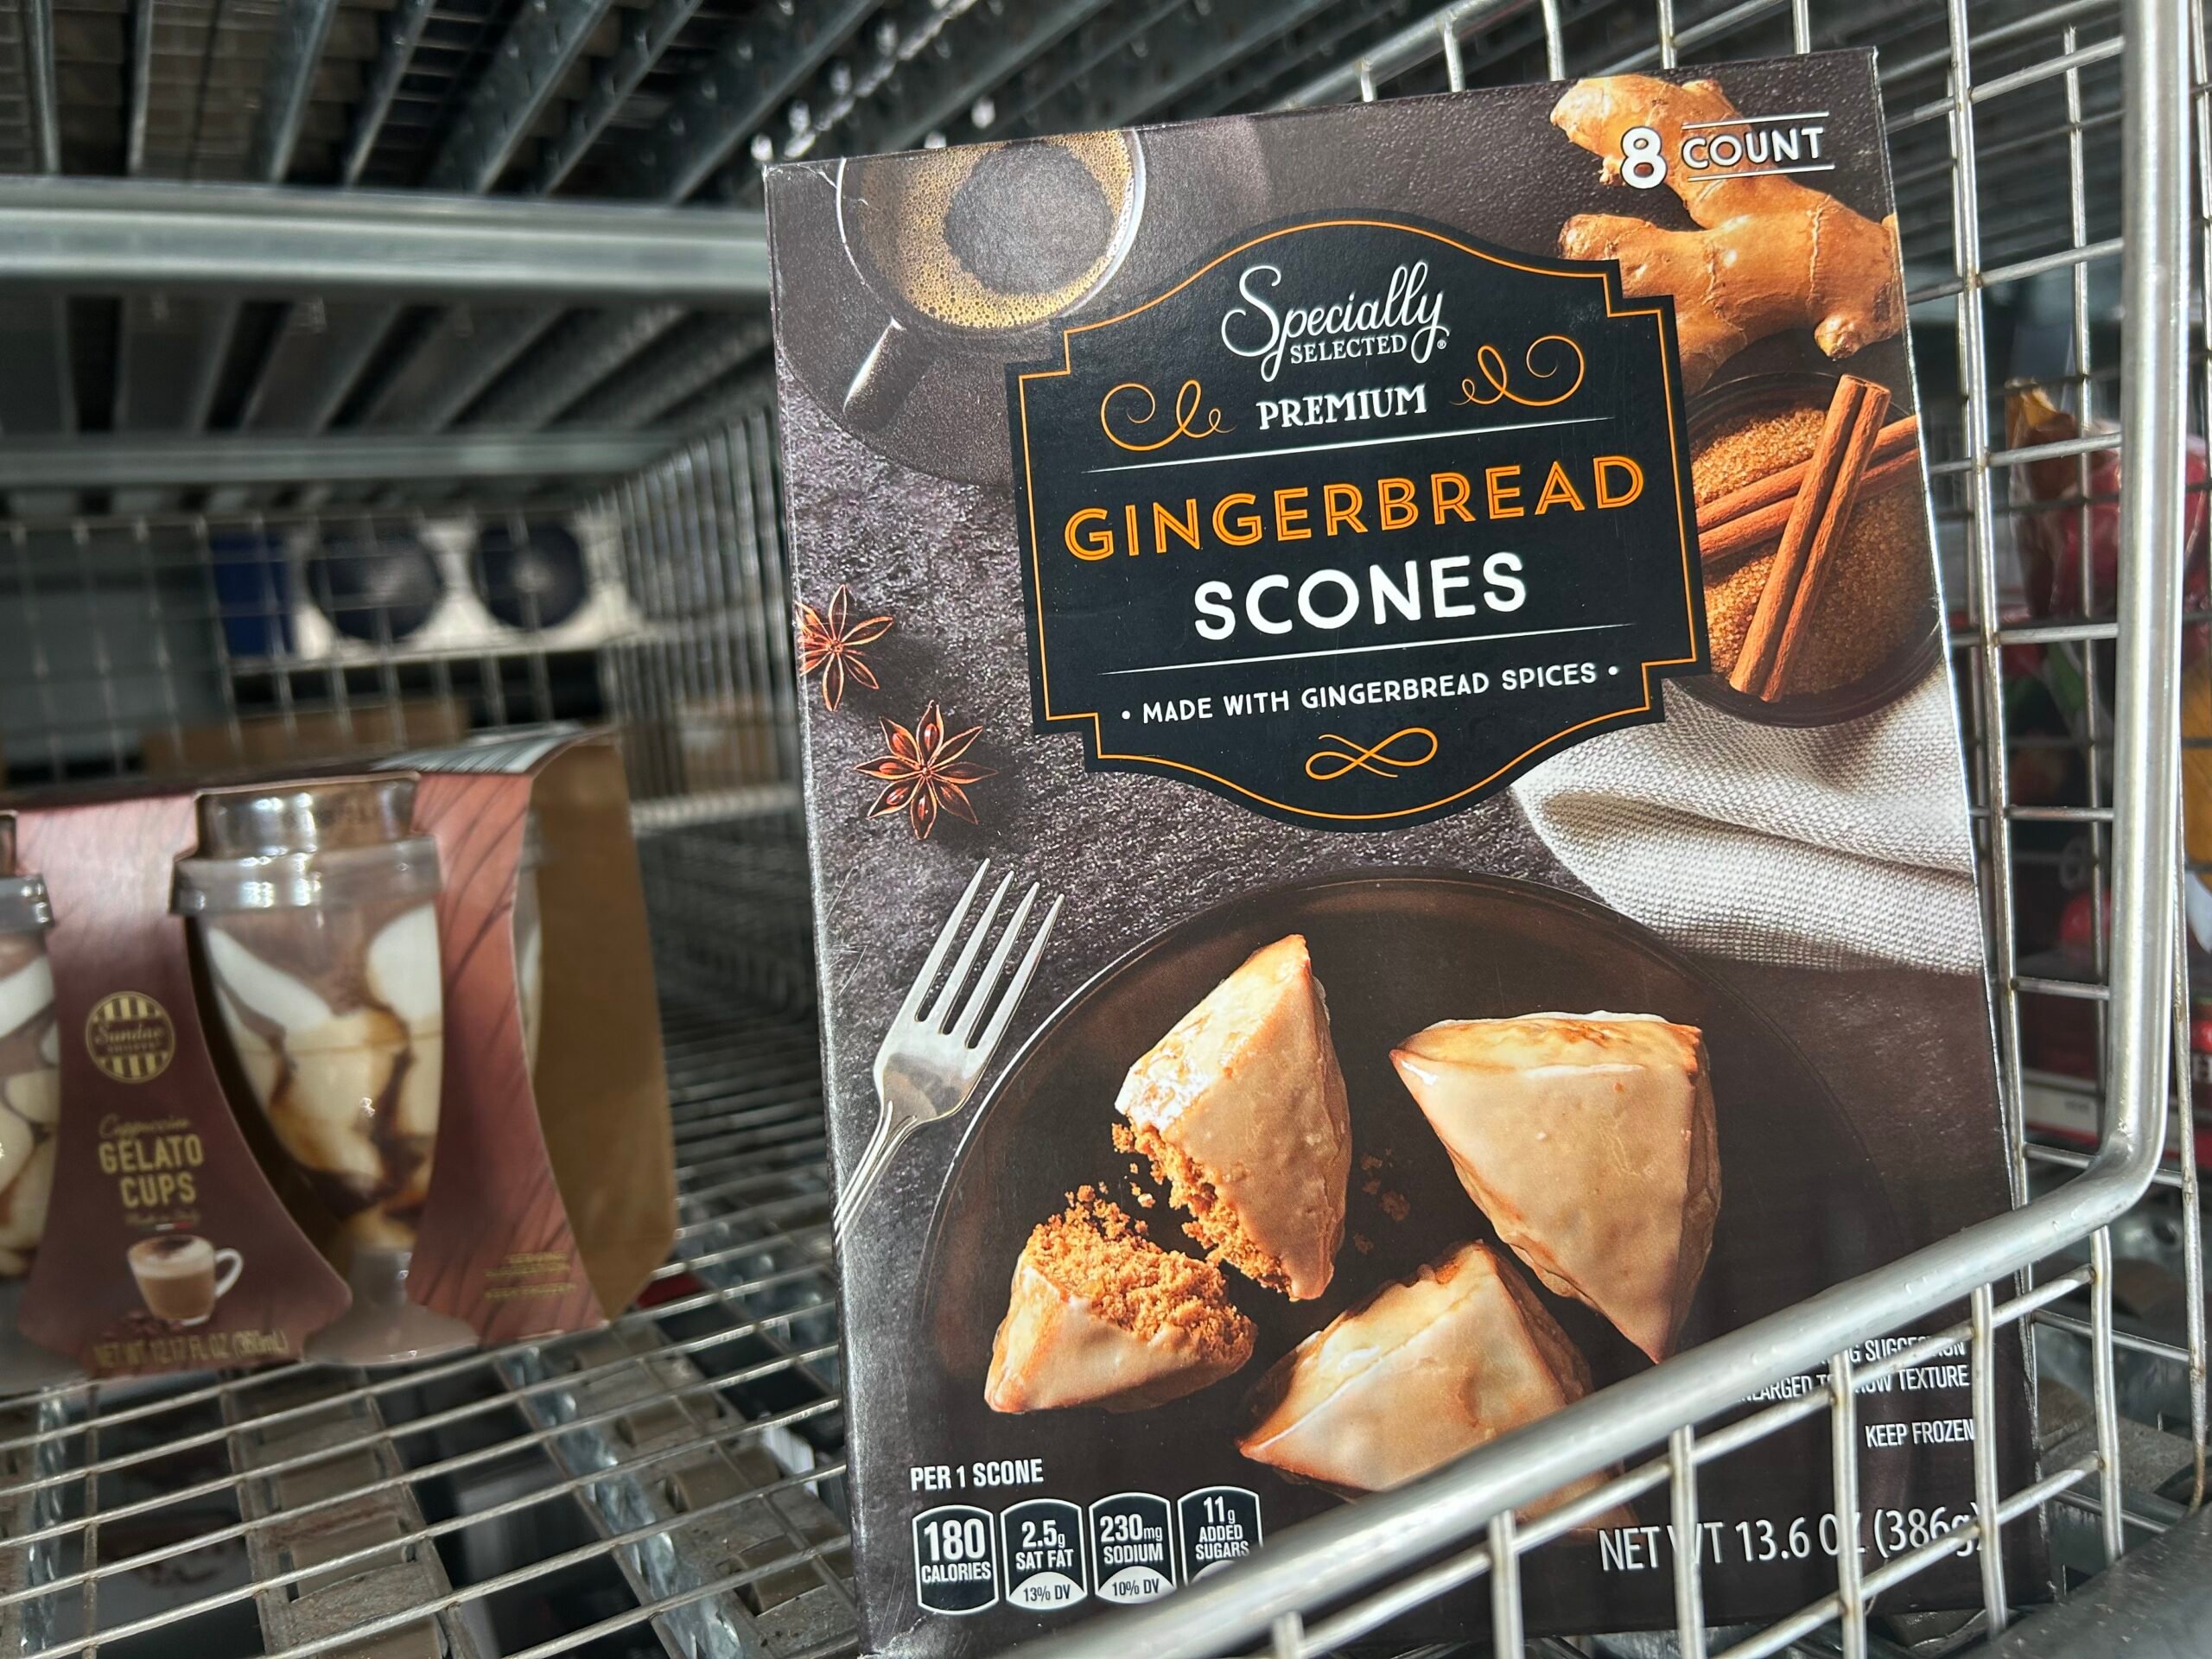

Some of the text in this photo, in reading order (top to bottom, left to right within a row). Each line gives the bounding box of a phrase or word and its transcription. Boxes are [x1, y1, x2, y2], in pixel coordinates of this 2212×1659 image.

[1621, 126, 1824, 189] 8 COUNT
[1221, 260, 1450, 382] Specially
[1289, 333, 1408, 365] SELECTED
[1255, 385, 1427, 430] PREMIUM
[1064, 455, 1644, 562] GINGERBREAD
[1193, 551, 1527, 640] SCONES
[1142, 662, 1598, 724] MADE WITH GINGERBREAD SPICES
[98, 1133, 205, 1174] GELATO
[119, 1171, 197, 1209] CUPS
[1897, 1364, 1970, 1391] TEXTURE
[1865, 1418, 1975, 1448] KEEP FROZEN
[910, 1458, 1045, 1491] PER 1 SCONE
[1203, 1496, 1236, 1524] 11g
[924, 1517, 986, 1562] 180
[1021, 1519, 1065, 1549] 2.5g
[1099, 1513, 1163, 1542] 230mg
[1198, 1523, 1243, 1543] ADDED
[1015, 1548, 1075, 1571] SAT FAT
[1103, 1542, 1164, 1565] SODIUM
[1195, 1540, 1250, 1560] SUGARS
[1599, 1525, 1661, 1572] NET
[1734, 1516, 1811, 1563] 13.6
[921, 1560, 992, 1584] CALORIES
[1112, 1578, 1160, 1597] 10% DV
[1023, 1584, 1071, 1602] 13% DV
